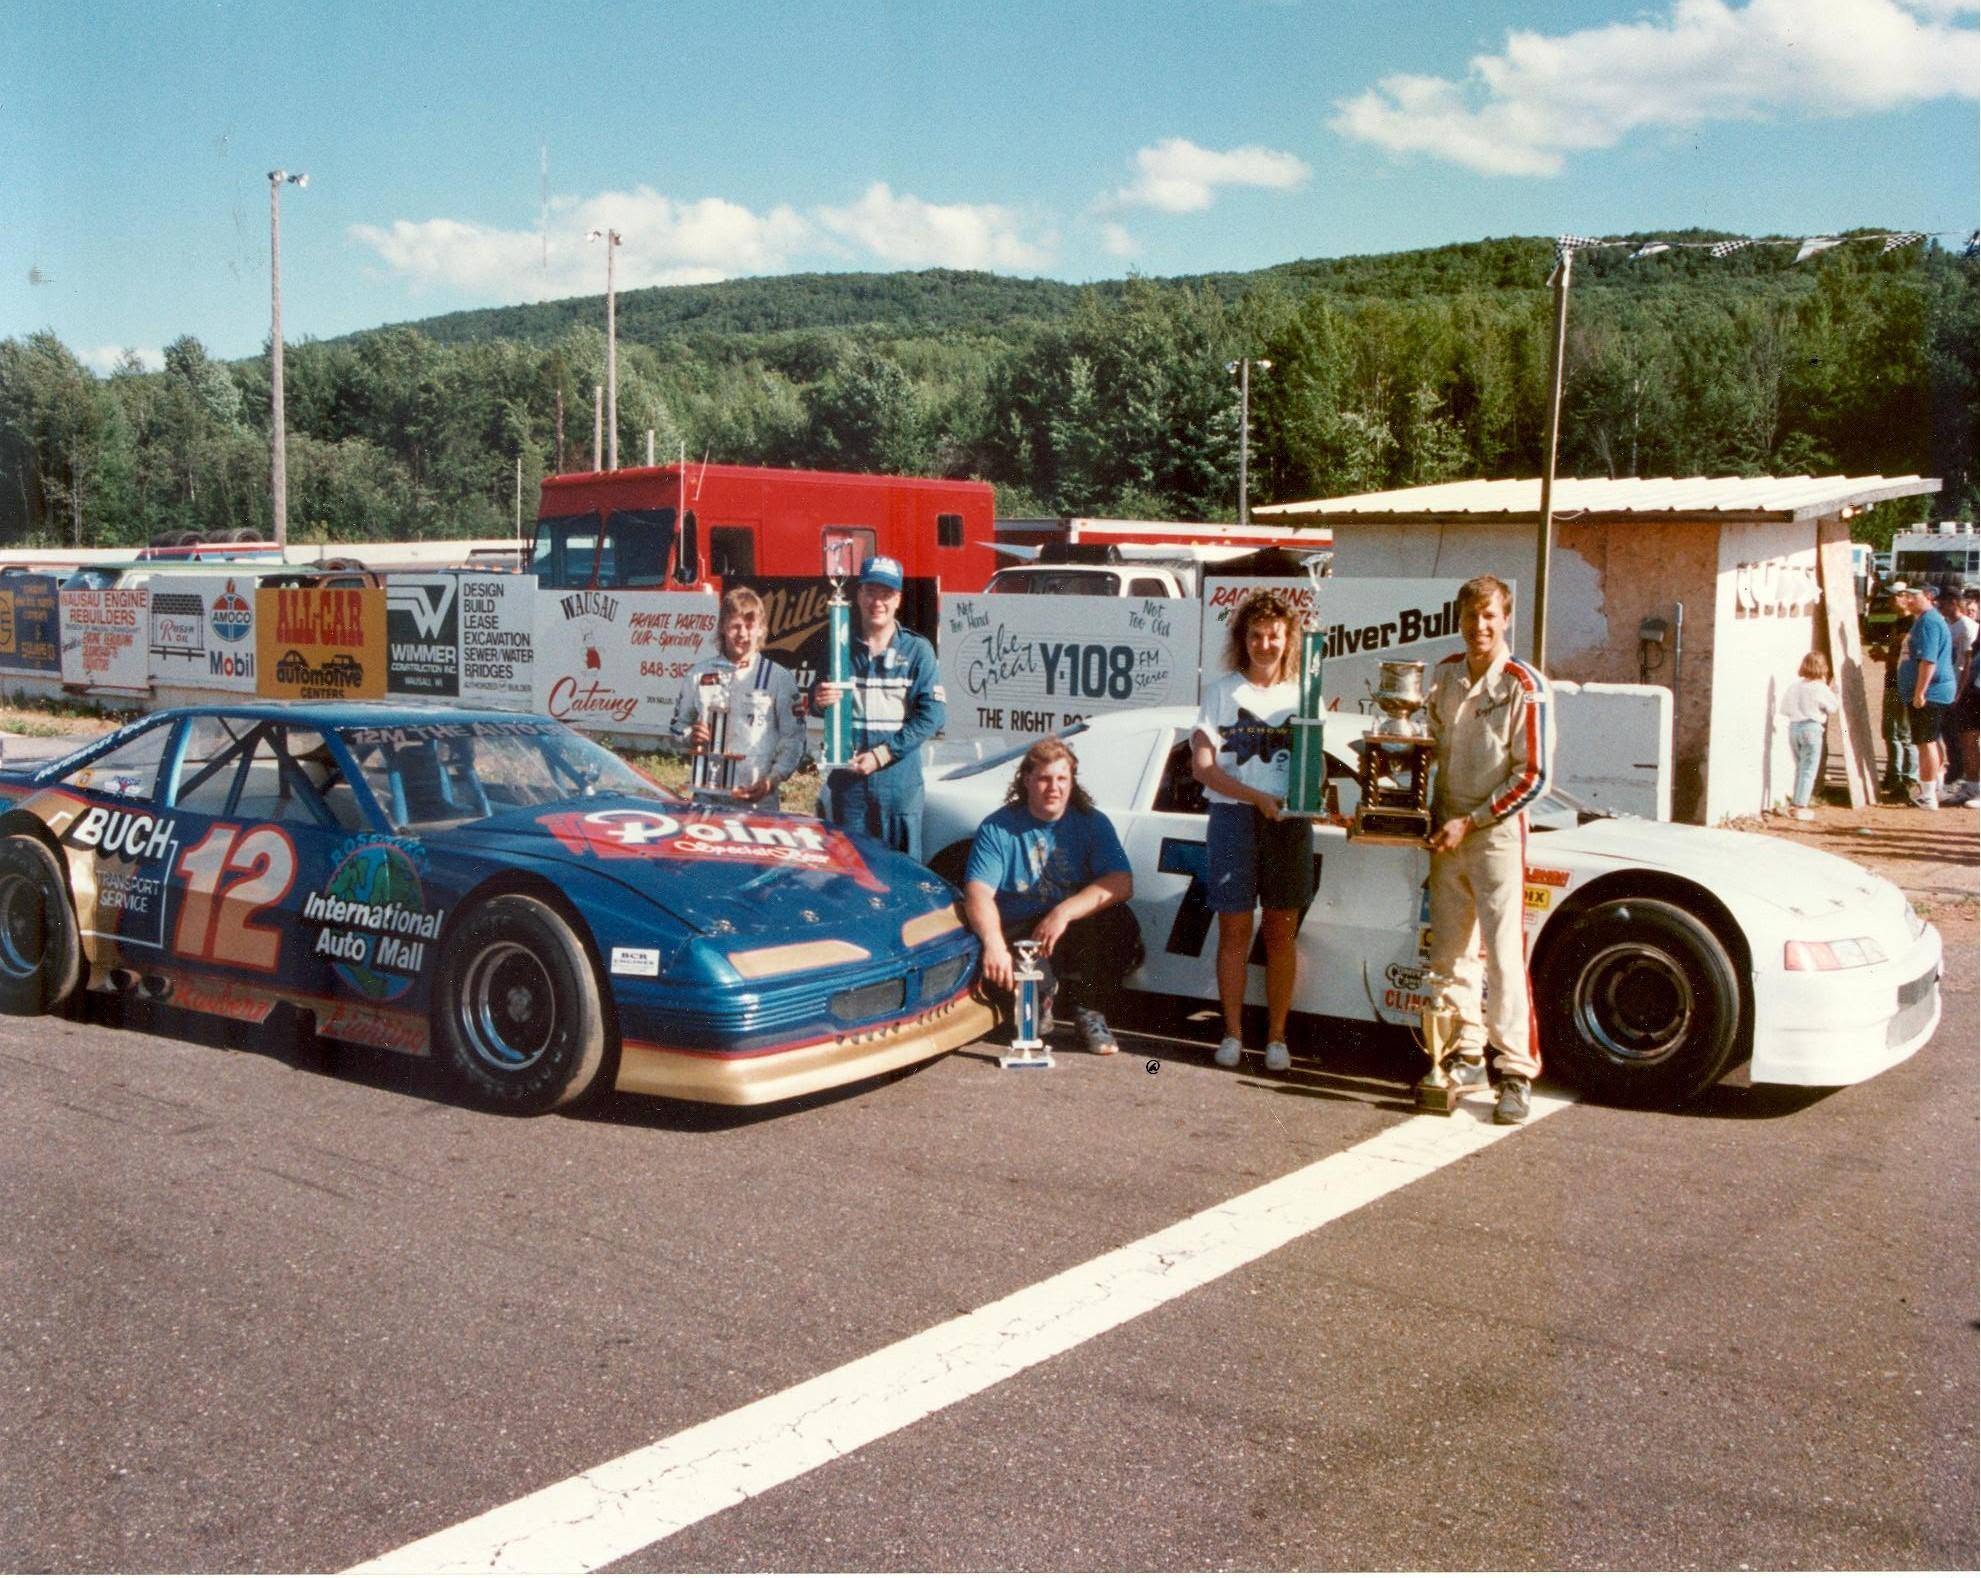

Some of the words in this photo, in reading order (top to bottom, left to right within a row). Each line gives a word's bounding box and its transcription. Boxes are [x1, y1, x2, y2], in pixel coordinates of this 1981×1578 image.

[60, 591, 100, 608] WAUSAU
[104, 592, 147, 609] ENGINE
[463, 582, 504, 597] DESIGN
[1209, 586, 1249, 607] RAC
[70, 609, 136, 625] REBUILDERS
[463, 599, 495, 613] BUILD
[561, 592, 619, 622] WAUSAU
[761, 585, 828, 635] Mille
[1143, 600, 1166, 618] Not
[212, 611, 250, 625] AMOCO
[277, 589, 364, 647] ALL-CAR
[463, 615, 499, 629] LEASE
[629, 612, 672, 629] PRIVATE
[674, 613, 717, 631] PARTIES
[1398, 600, 1460, 644] Bull
[463, 632, 531, 646] EXCAVATION
[982, 624, 1018, 665] The
[391, 643, 457, 663] WIMMER
[1139, 649, 1160, 667] FM
[210, 651, 254, 678] Mobil
[391, 662, 441, 673] CONSTRUCTION
[463, 664, 514, 679] BRIDGES
[968, 641, 1038, 699] Great
[277, 667, 363, 688] automotive
[301, 687, 344, 699] CENTERS
[548, 676, 639, 721] Catering
[976, 707, 1004, 729] THE
[1011, 710, 1055, 733] RIGHT
[72, 807, 175, 859] BUCH
[584, 809, 827, 851] Point
[96, 870, 160, 896] TRANSPORT
[100, 890, 149, 913] SERVICE
[174, 822, 298, 971] 12
[304, 891, 444, 940] International
[315, 927, 366, 961] Auto
[376, 936, 424, 971] Mall
